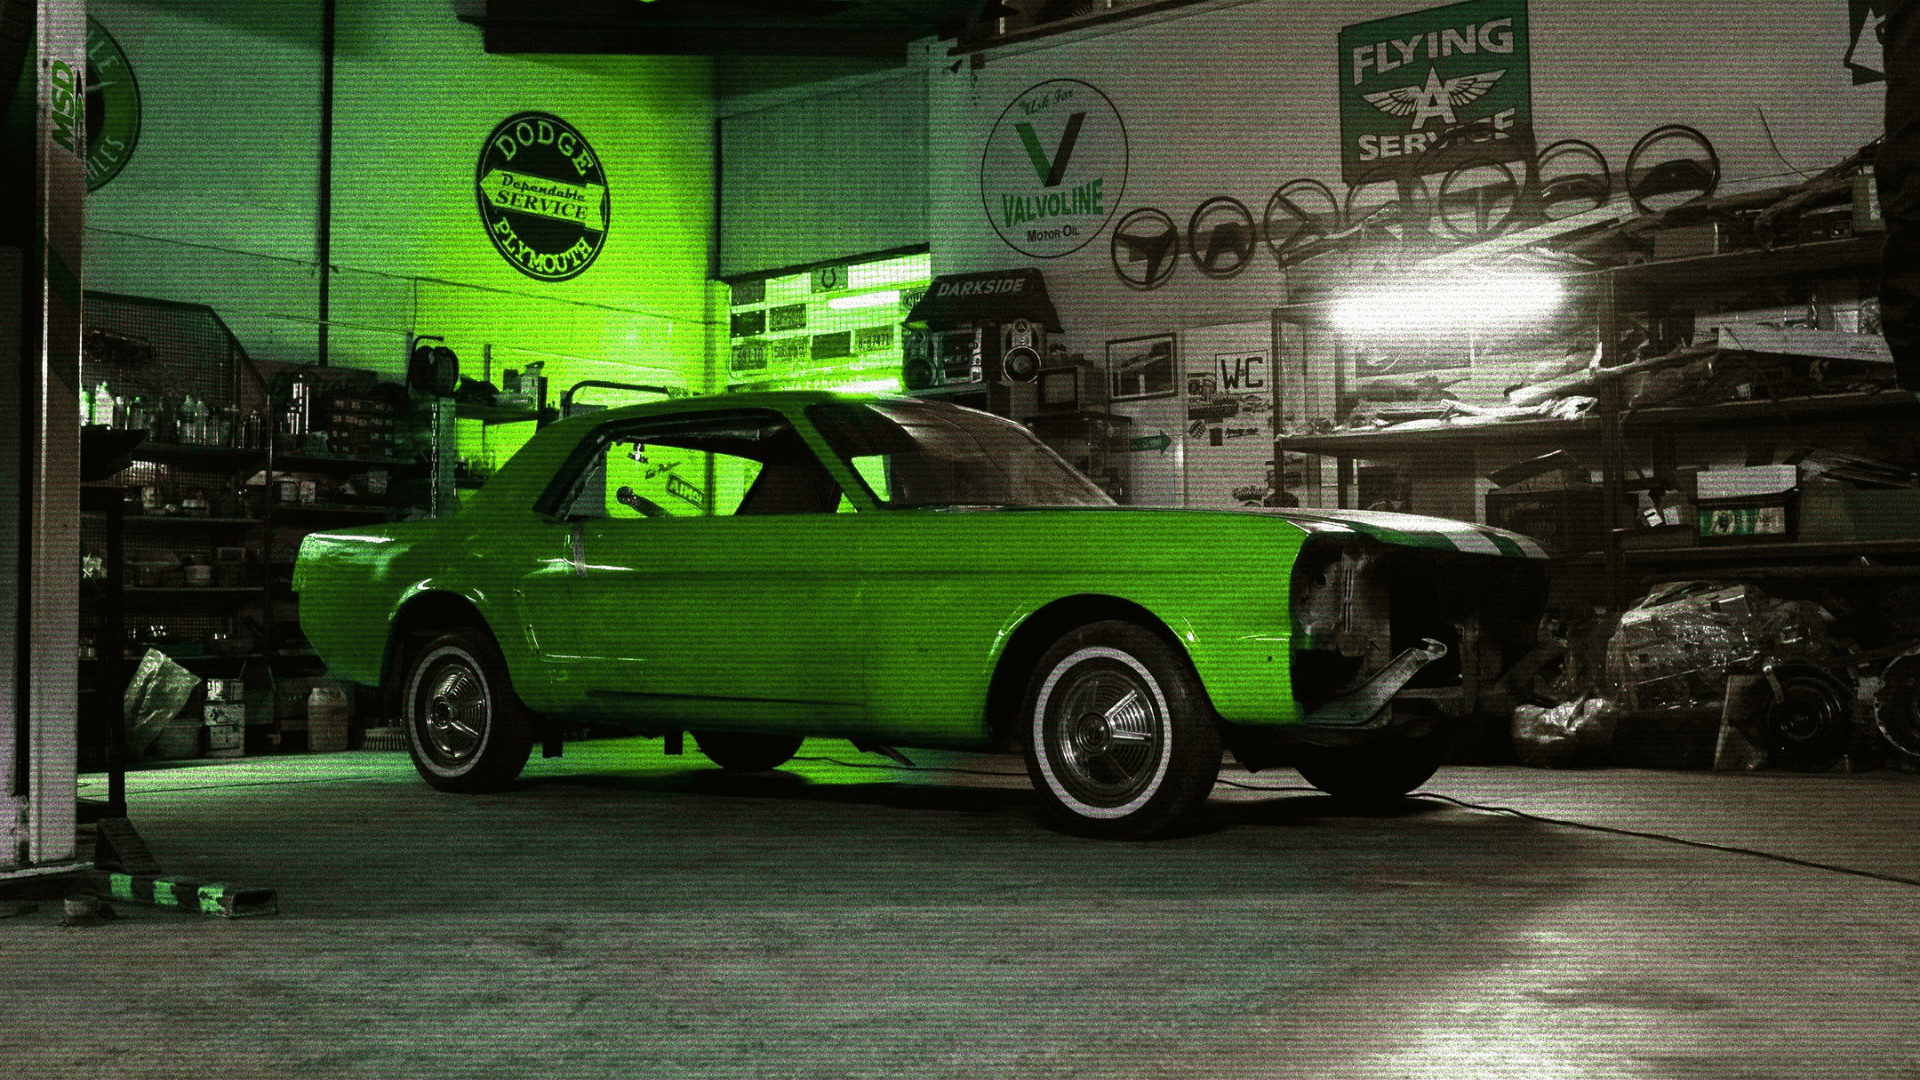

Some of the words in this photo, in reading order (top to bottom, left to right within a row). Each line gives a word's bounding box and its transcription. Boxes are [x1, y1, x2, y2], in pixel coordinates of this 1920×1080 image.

[1353, 17, 1514, 86] FLYING
[51, 60, 75, 153] MSD
[496, 121, 594, 176] DODGE
[1358, 107, 1515, 161] SERE
[496, 190, 588, 219] SERVICE
[501, 173, 585, 202] Dependable
[1002, 178, 1104, 228] VALVOLINE
[493, 217, 593, 273] PLYMOUTH
[937, 278, 1026, 296] DARKSIDE
